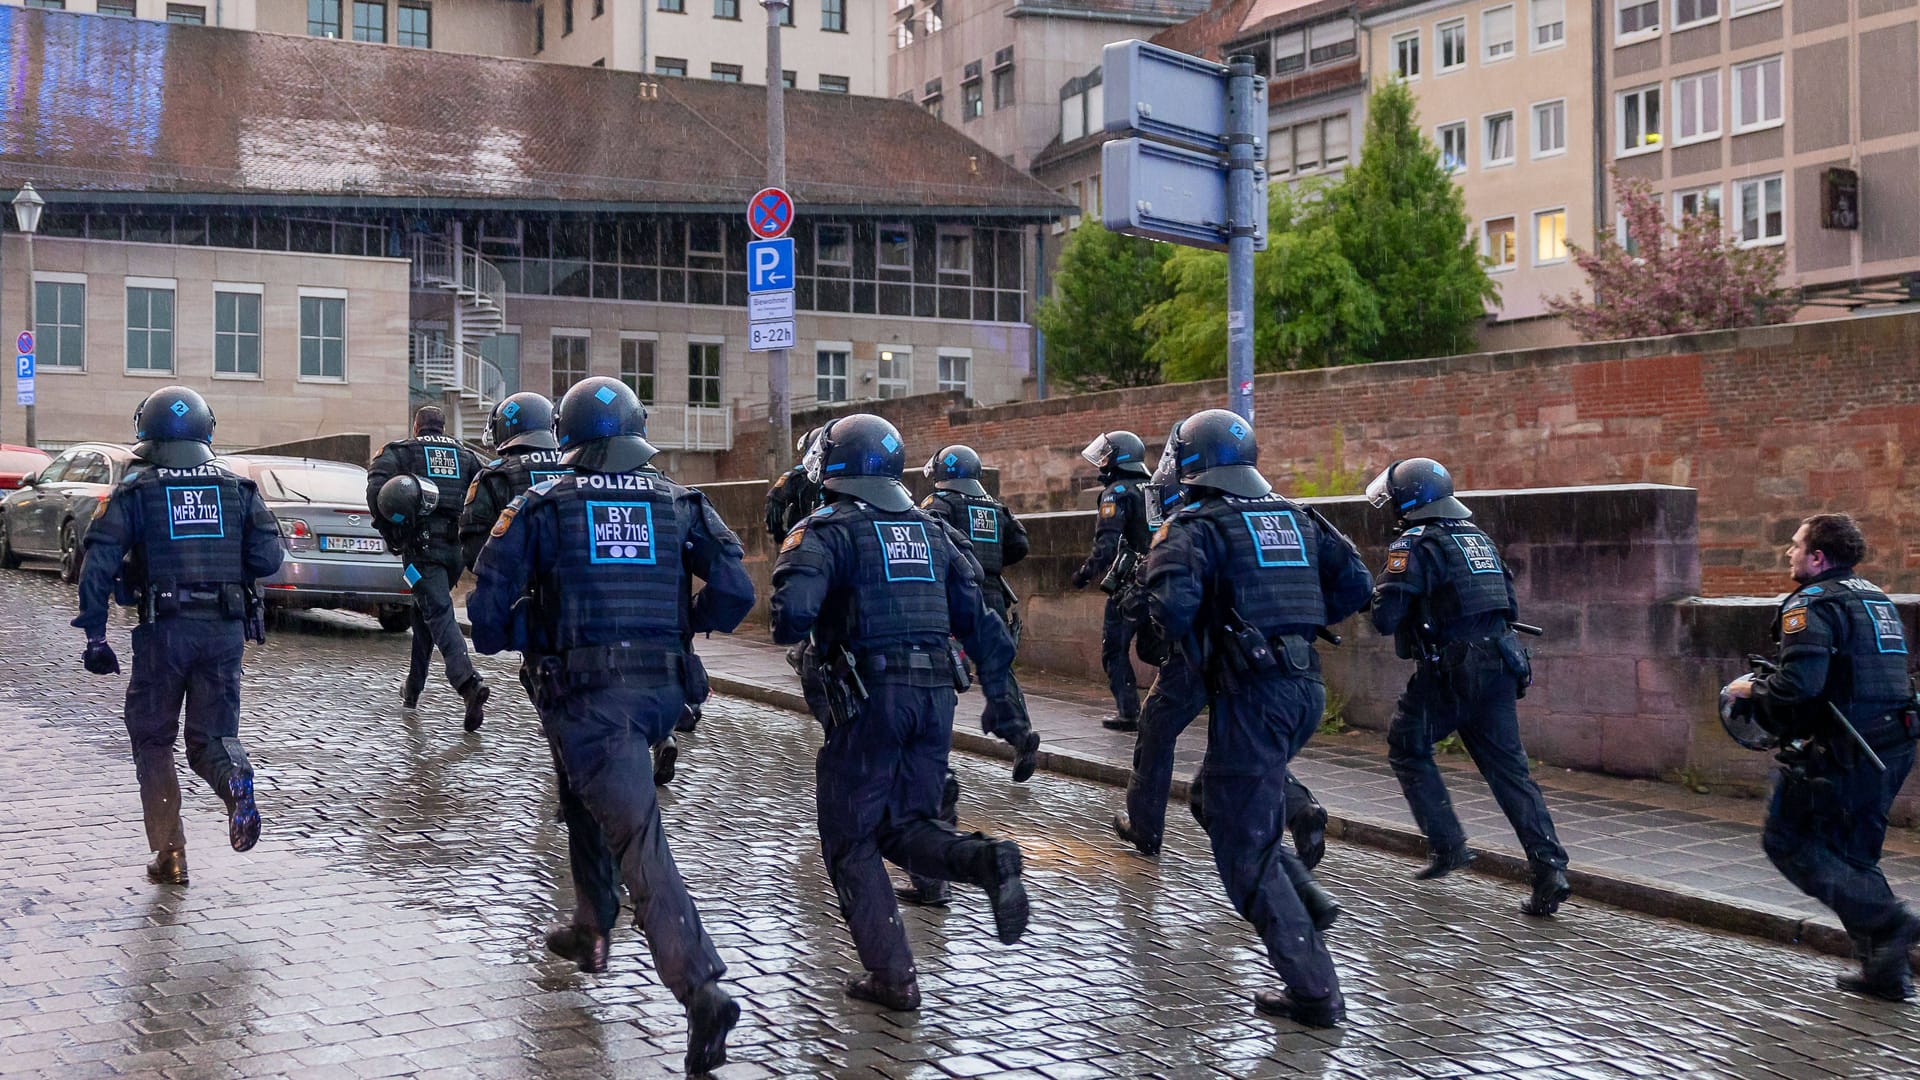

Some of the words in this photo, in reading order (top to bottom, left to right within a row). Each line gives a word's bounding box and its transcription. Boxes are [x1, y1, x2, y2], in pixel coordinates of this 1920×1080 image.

[756, 247, 780, 286] P
[176, 403, 184, 412] 2
[1235, 426, 1243, 435] 2
[434, 449, 447, 458] BY
[183, 490, 203, 505] BY
[173, 504, 196, 520] MFR
[197, 504, 218, 519] 7112
[607, 506, 632, 523] BY
[976, 509, 988, 519] BY
[1260, 515, 1282, 530] BY
[595, 523, 622, 541] MFR
[623, 523, 649, 541] 7116
[890, 526, 912, 541] BY
[1256, 529, 1280, 545] MFR
[885, 542, 909, 559] MFR
[908, 542, 929, 559] 7112
